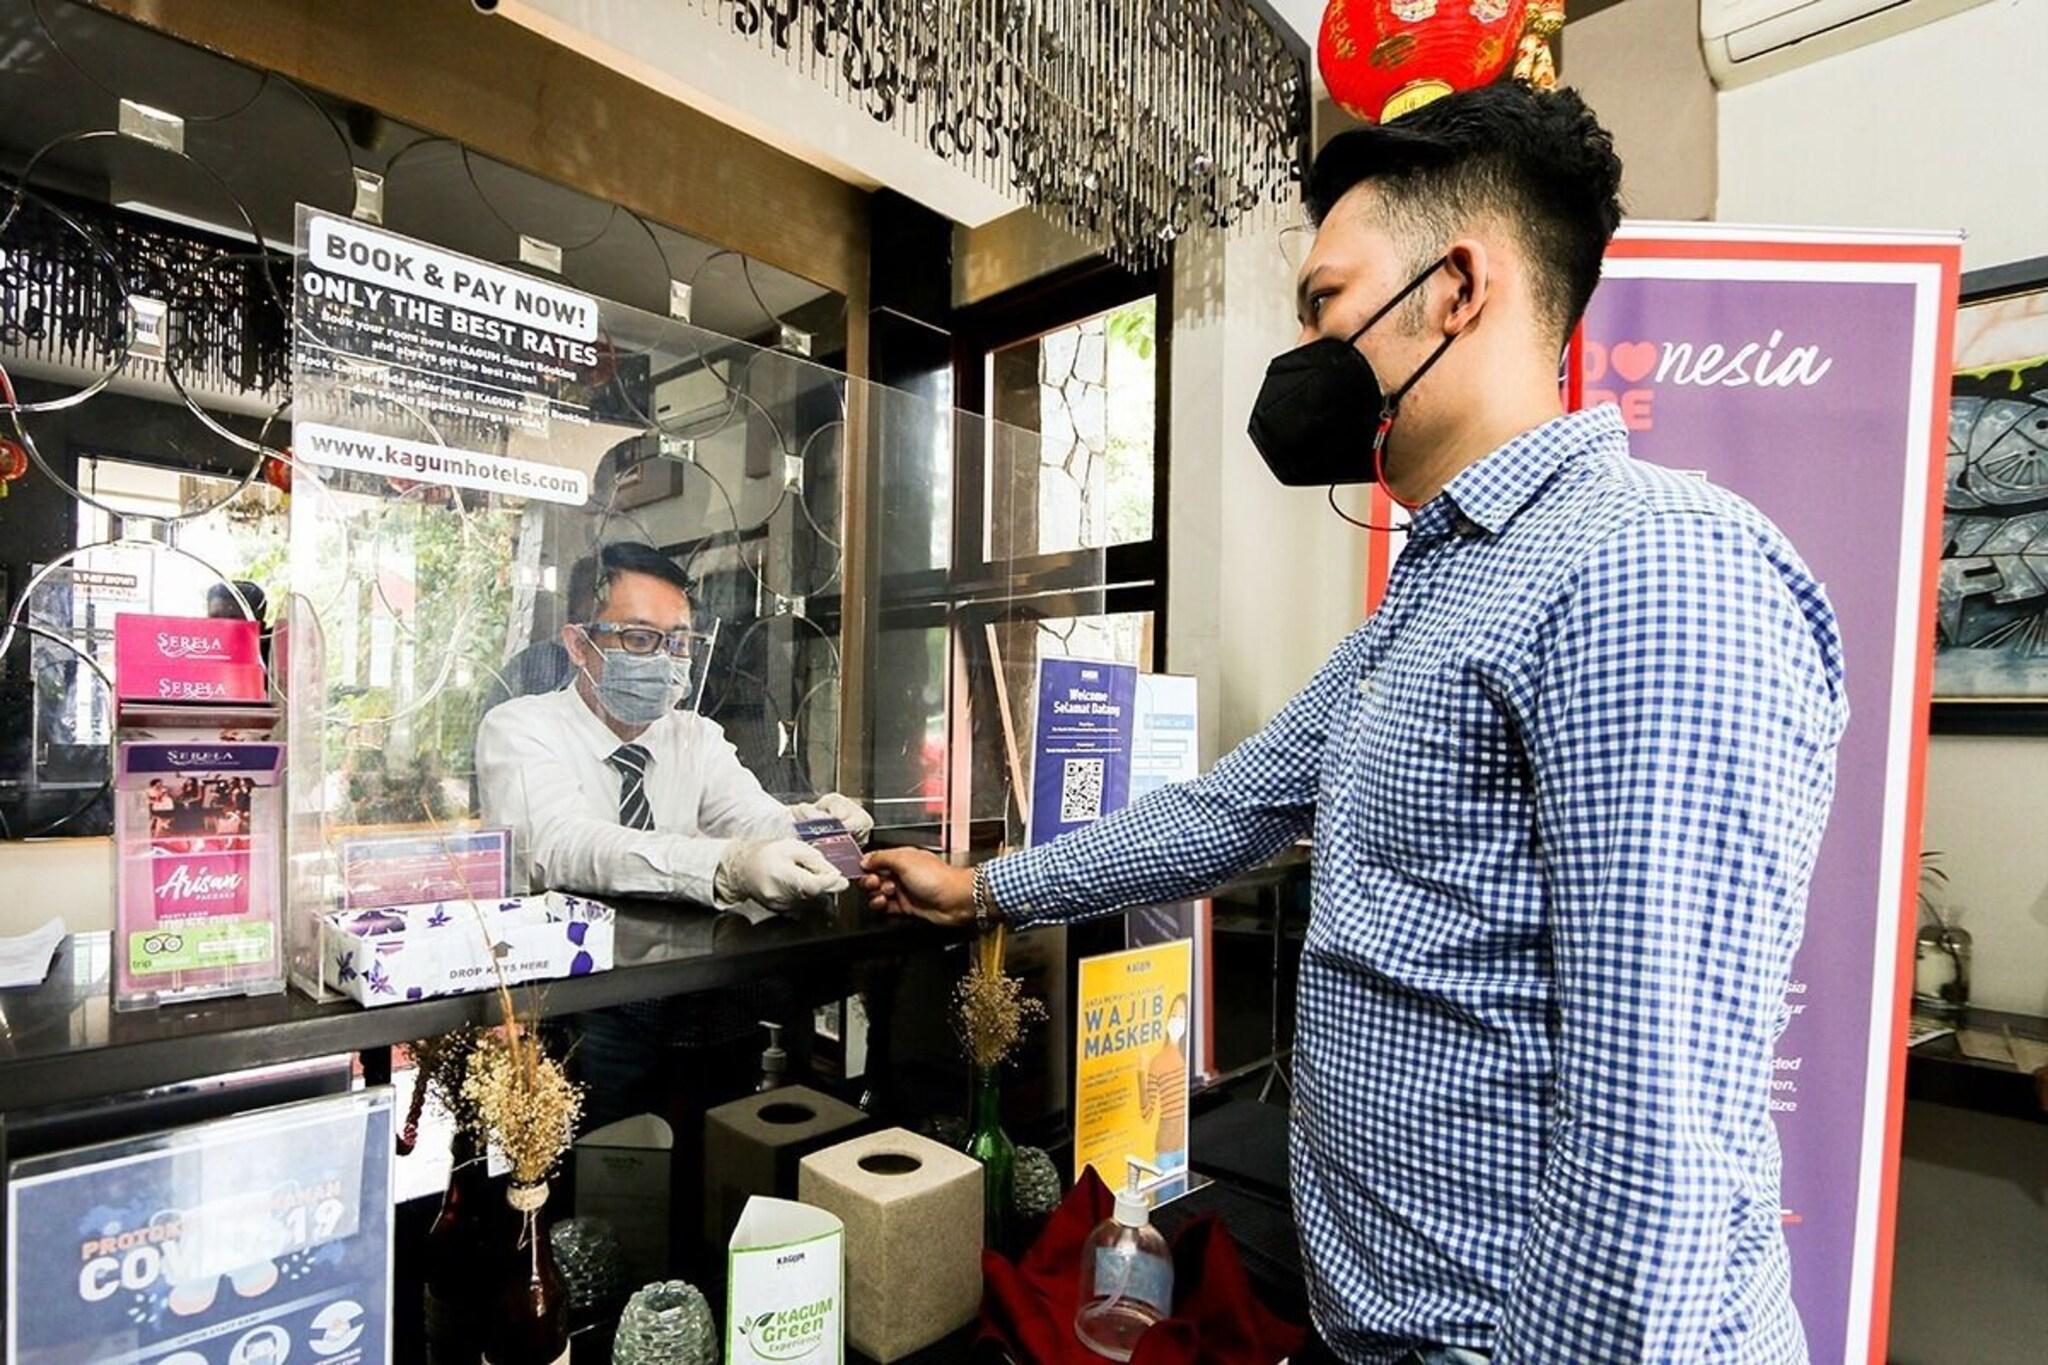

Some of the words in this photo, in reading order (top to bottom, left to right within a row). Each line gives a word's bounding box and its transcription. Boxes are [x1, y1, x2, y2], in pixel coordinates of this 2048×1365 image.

[326, 233, 414, 281] BOOK
[424, 264, 445, 290] &
[454, 271, 506, 305] PAY
[515, 288, 586, 329] NOW!
[303, 272, 383, 311] ONLY
[390, 294, 444, 328] THE
[451, 311, 517, 346] BEST
[523, 330, 598, 367] RATES
[387, 328, 419, 343] room
[459, 343, 501, 363] KAGUM
[502, 354, 535, 370] Smart
[536, 362, 577, 383] Booking
[460, 358, 478, 372] the
[481, 364, 504, 377] best
[297, 353, 331, 369] Book
[476, 392, 516, 409] KAGUM
[311, 434, 580, 496] www.kagumhotels.com
[155, 864, 242, 900] Arisan
[449, 966, 482, 980] DROP
[486, 963, 517, 975] KYS
[520, 960, 550, 971] HERE
[1084, 994, 1164, 1034] WAJIB
[1084, 1020, 1162, 1060] MASKER
[762, 1316, 824, 1344] Green
[776, 1296, 833, 1326] KAGUM
